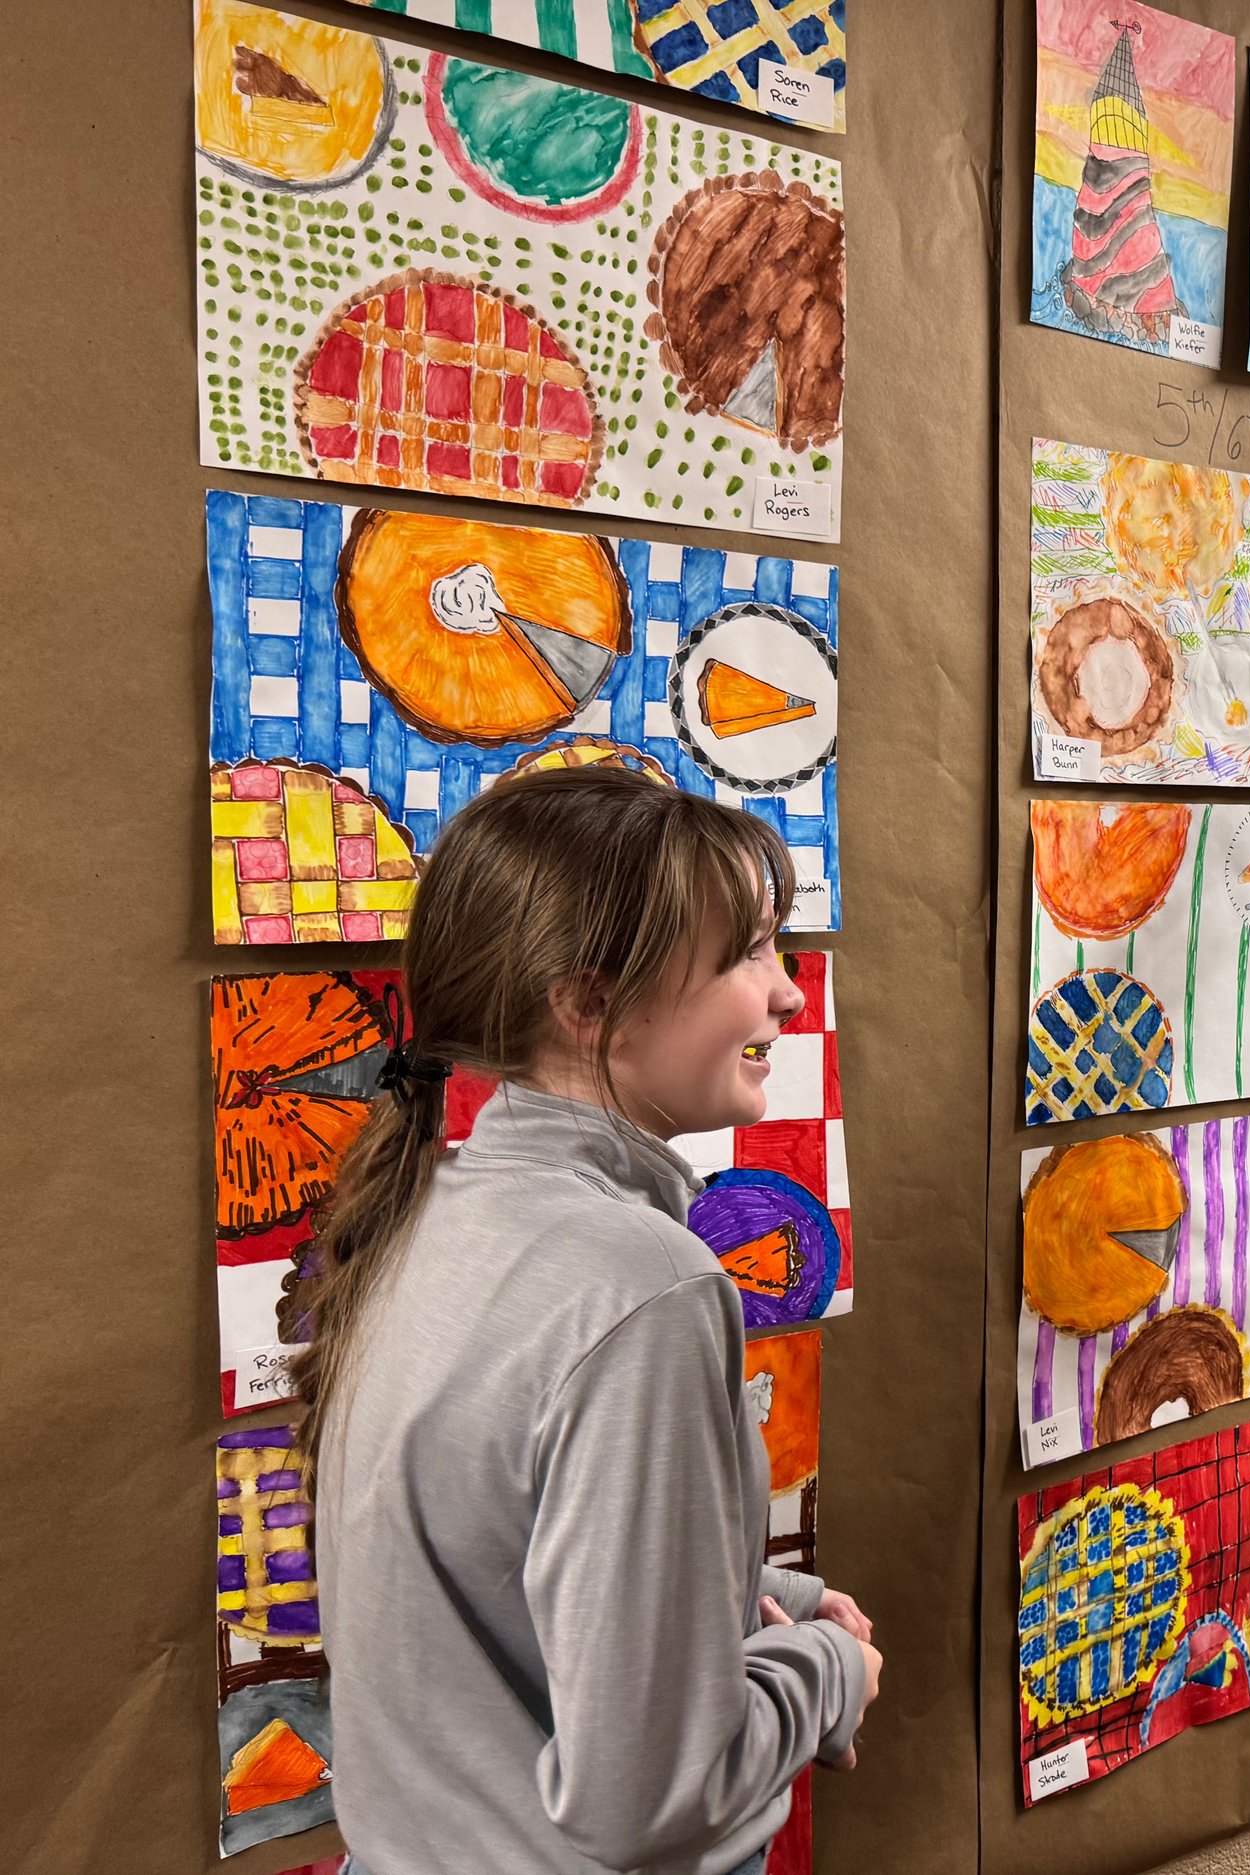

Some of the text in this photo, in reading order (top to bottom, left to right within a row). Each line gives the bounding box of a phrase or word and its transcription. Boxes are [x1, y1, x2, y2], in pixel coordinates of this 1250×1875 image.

[774, 69, 811, 93] Soren
[769, 88, 799, 107] Rice
[1178, 322, 1206, 338] Wolfie
[1174, 337, 1206, 354] Kiefer
[774, 483, 799, 498] Levi
[764, 499, 811, 521] Rogers
[1051, 738, 1086, 757] Harper
[1052, 756, 1079, 769] Bunn
[1040, 1422, 1059, 1438] Levi
[1041, 1437, 1059, 1452] Nix
[1040, 1753, 1070, 1772] Hunter
